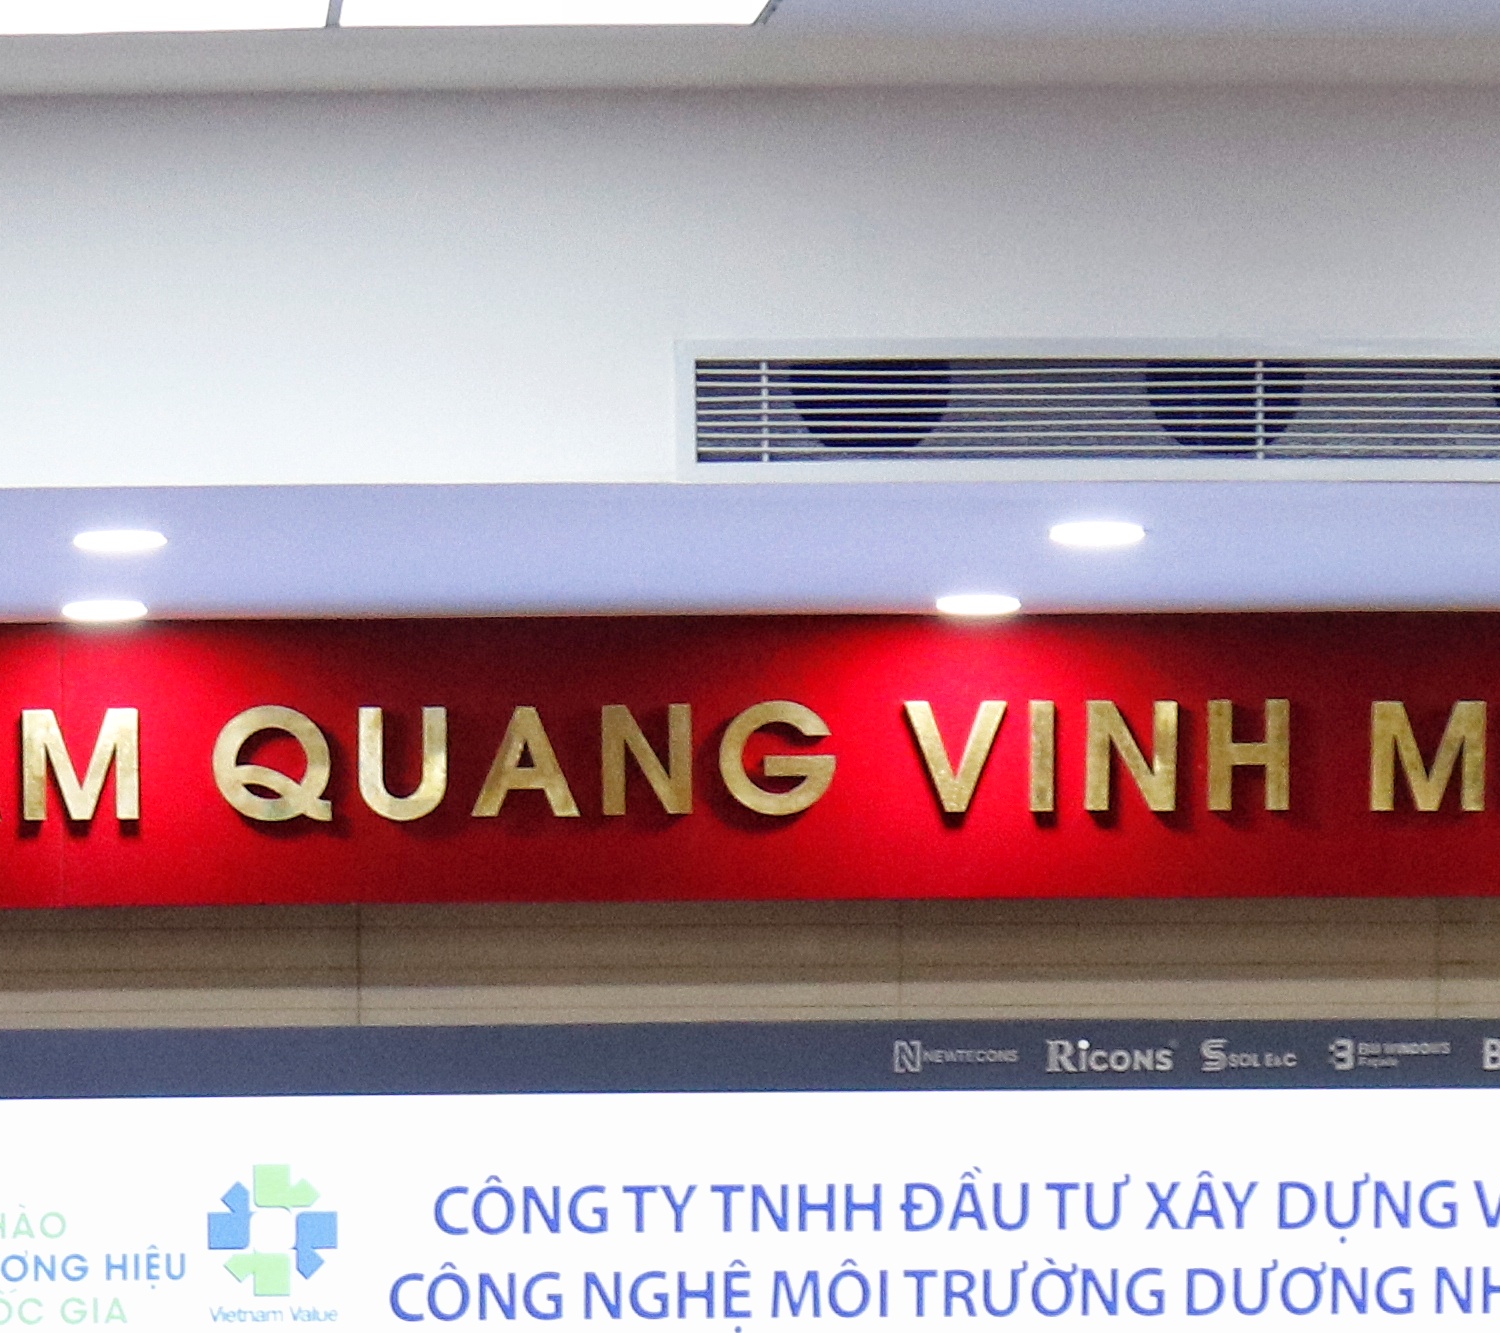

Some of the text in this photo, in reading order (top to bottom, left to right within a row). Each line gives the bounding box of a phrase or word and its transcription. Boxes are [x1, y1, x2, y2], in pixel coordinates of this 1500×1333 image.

[210, 699, 837, 830] QUANG
[902, 697, 1291, 814] VINH
[433, 1174, 609, 1236] CÔNG
[621, 1183, 698, 1234] TY
[709, 1182, 883, 1234] TNHH
[898, 1165, 1031, 1233] ĐẦU
[1044, 1172, 1132, 1232] TƯ
[1144, 1169, 1260, 1231] XÂY
[1276, 1171, 1459, 1245] DỰNG
[104, 1243, 187, 1290] HIỆU
[388, 1261, 564, 1323] CÔNG
[770, 1257, 889, 1319] MÔI
[902, 1256, 1166, 1318] TRƯỜNG
[1185, 1258, 1416, 1317] DƯƠNG
[59, 1296, 129, 1325] GIA
[209, 1306, 339, 1323] Vietnam Value
